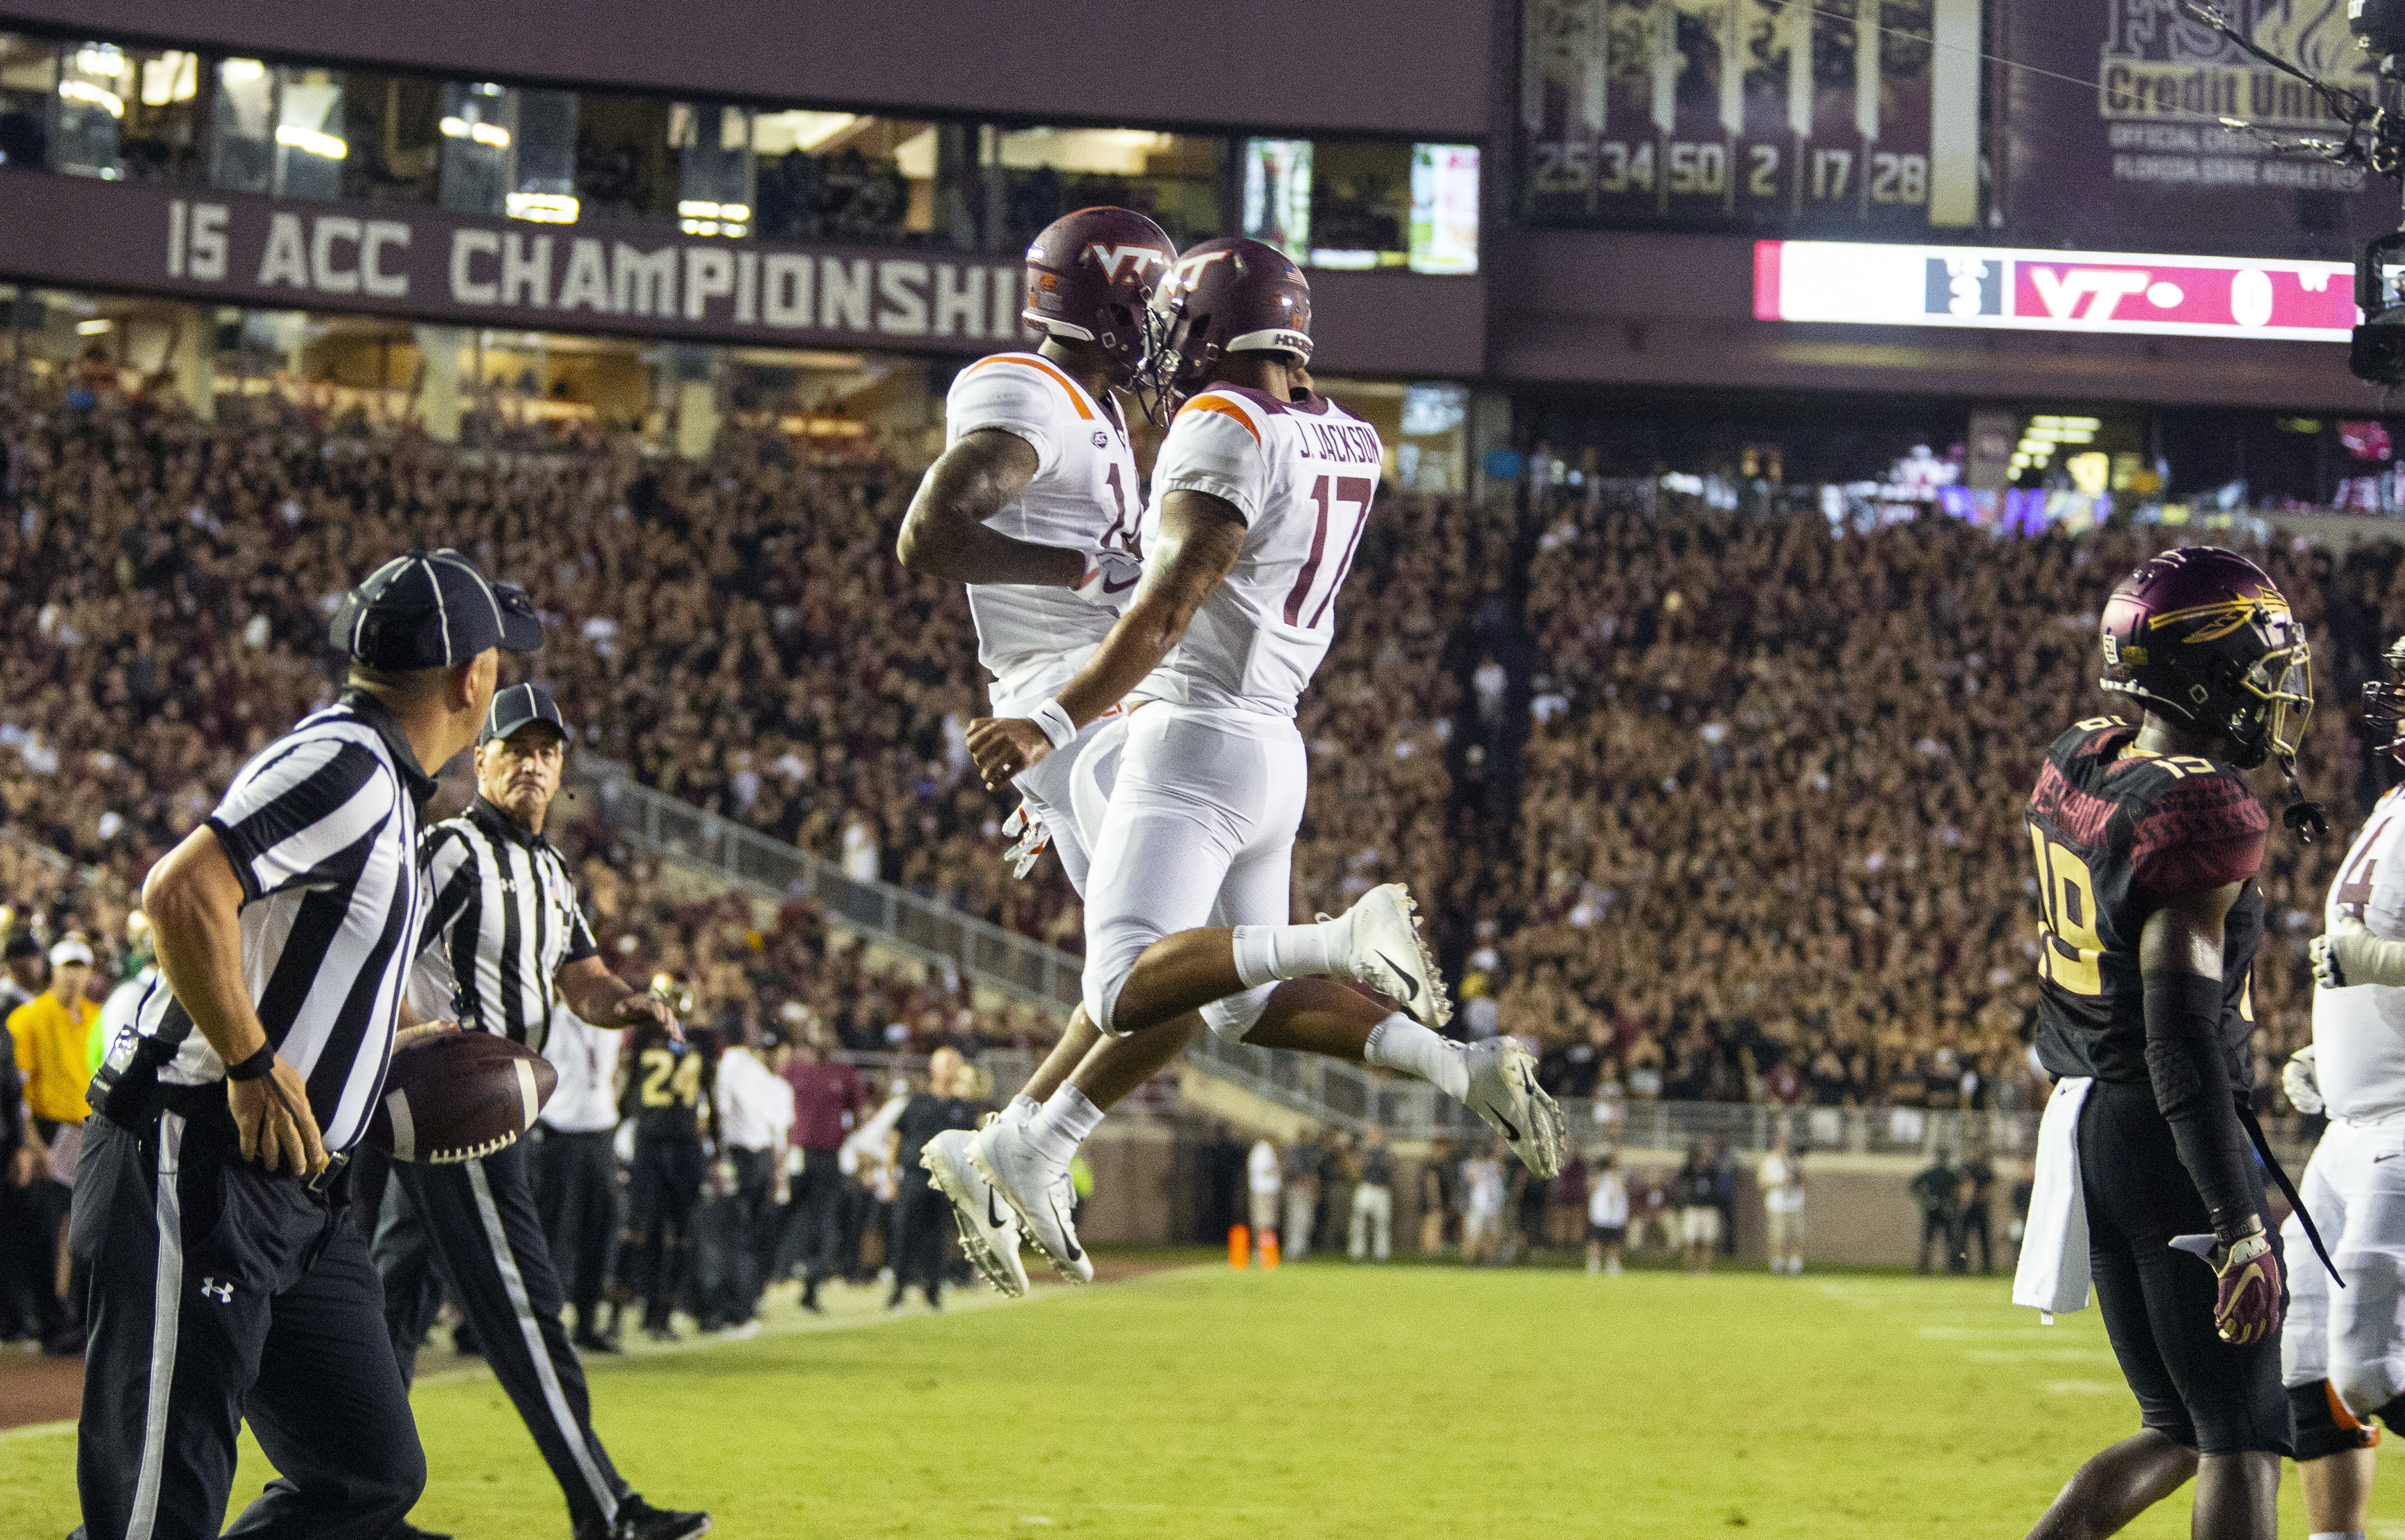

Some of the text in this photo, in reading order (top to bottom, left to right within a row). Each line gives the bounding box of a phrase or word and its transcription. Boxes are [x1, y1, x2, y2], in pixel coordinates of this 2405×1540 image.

[2107, 65, 2239, 114] Credit
[1600, 141, 1654, 193] 34
[1670, 141, 1725, 195] 50
[1748, 144, 1779, 196] 2
[1812, 148, 1853, 201] 17
[1872, 153, 1928, 205] 28
[168, 199, 1043, 342] 15 ACC CHAMPIONSHI
[1088, 242, 1165, 285] VT
[2029, 266, 2152, 321] VT
[2230, 268, 2273, 327] 0
[1294, 420, 1382, 466] J. JACKSON
[1283, 474, 1372, 629] 17
[2029, 821, 2108, 996] 19
[640, 1049, 703, 1107] 24
